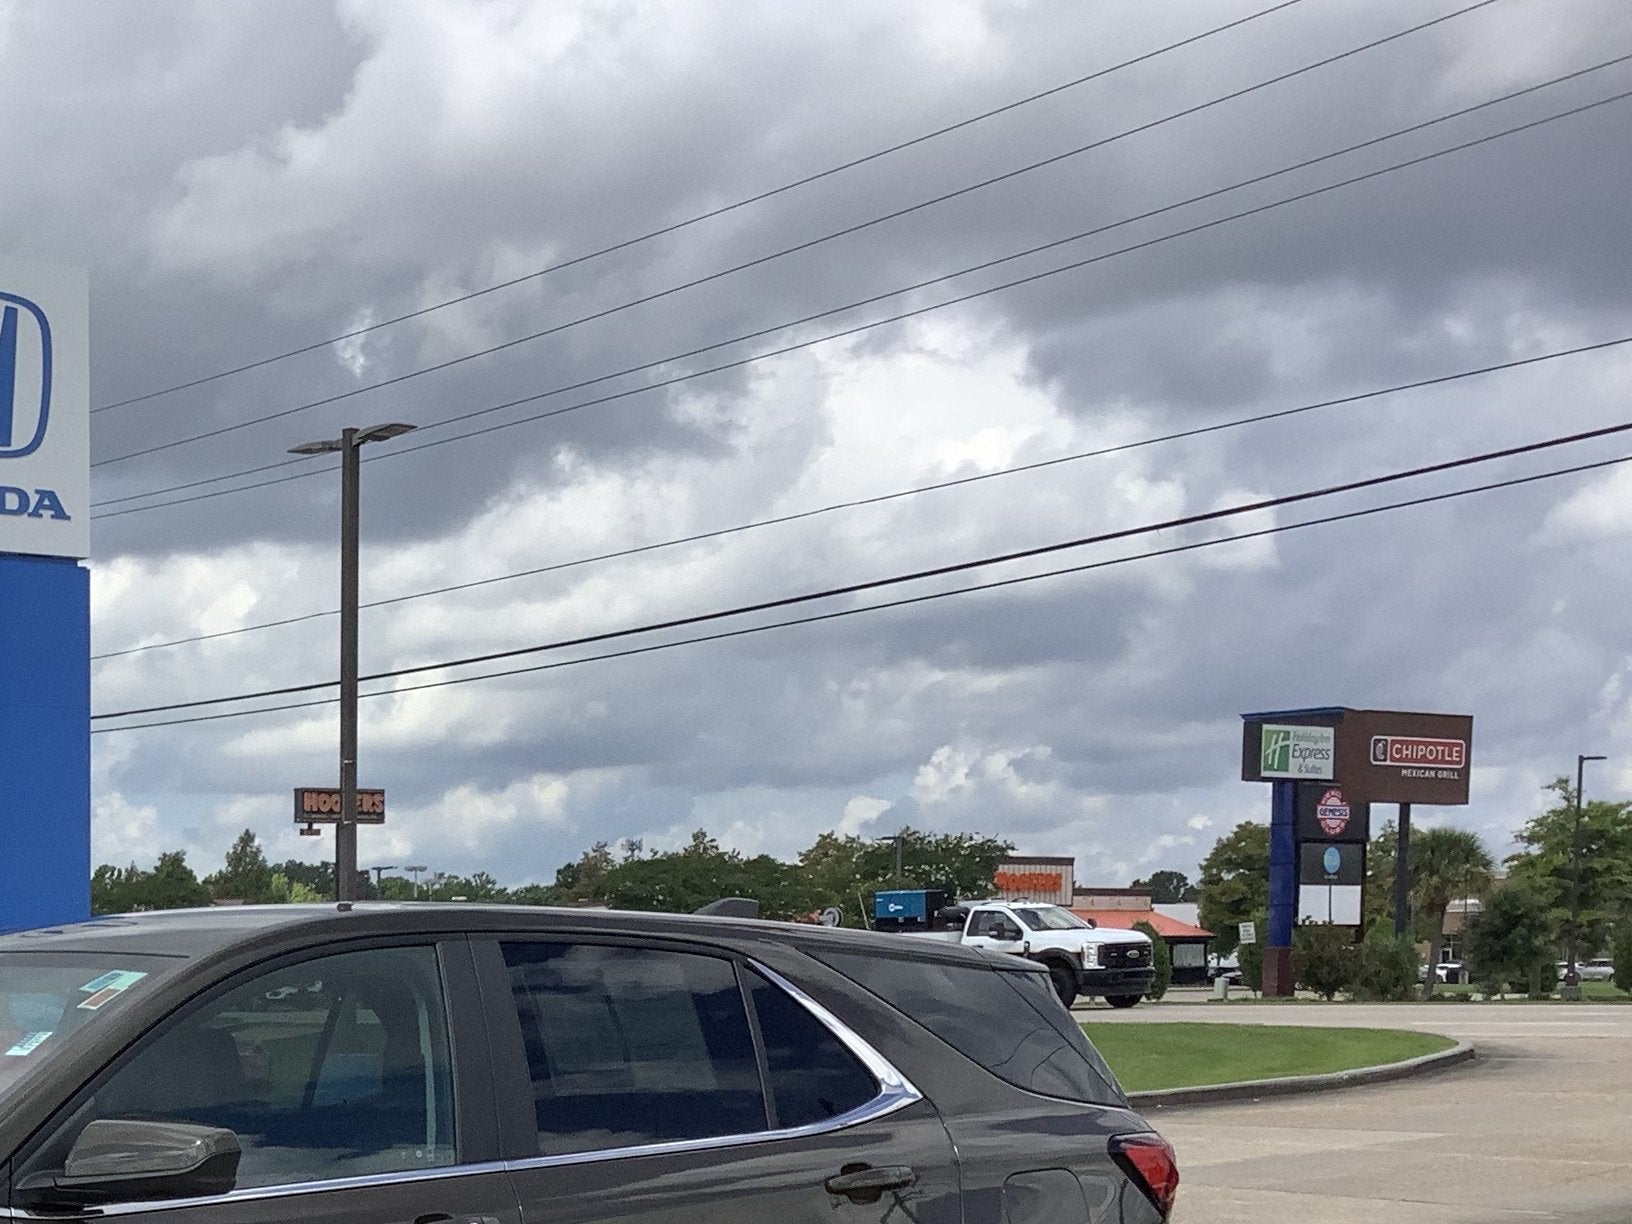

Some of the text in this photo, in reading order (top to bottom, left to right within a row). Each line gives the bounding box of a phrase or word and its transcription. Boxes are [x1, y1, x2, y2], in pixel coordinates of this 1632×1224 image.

[1292, 743, 1331, 762] Express
[1392, 743, 1461, 761] CHIPOTLE
[1401, 768, 1459, 779] MEXICAN GRILL
[303, 791, 385, 813] HOOERS
[1319, 807, 1348, 817] GENESIS
